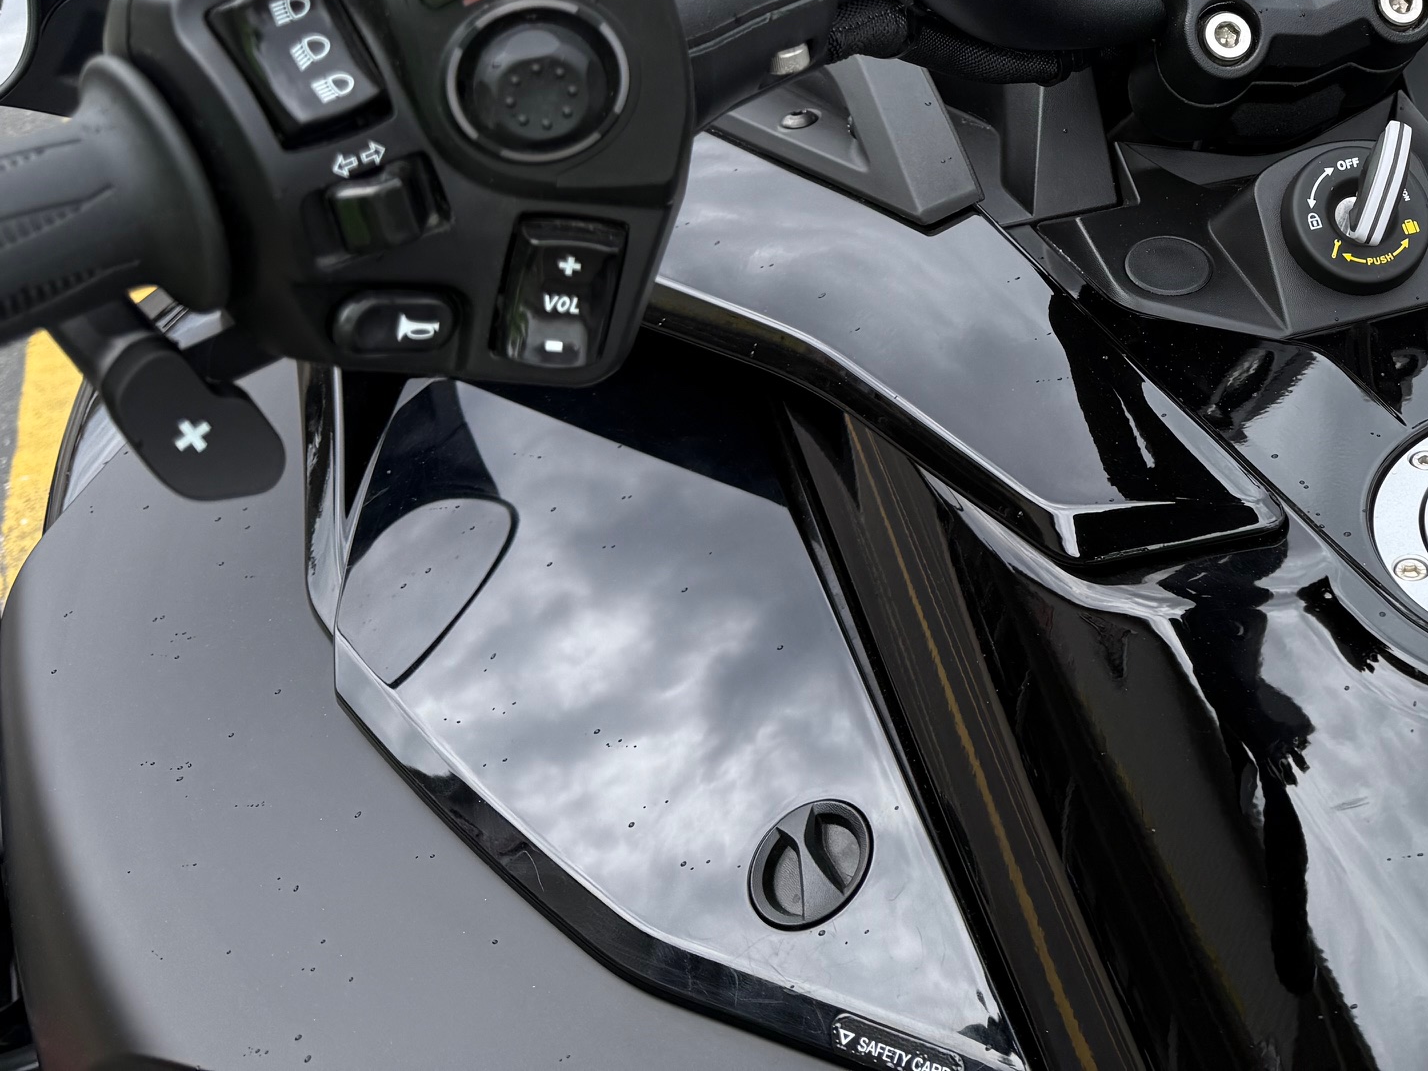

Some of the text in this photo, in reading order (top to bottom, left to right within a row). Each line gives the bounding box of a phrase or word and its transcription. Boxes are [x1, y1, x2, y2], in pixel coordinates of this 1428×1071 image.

[1336, 157, 1360, 171] OFF
[1367, 252, 1394, 266] PUSH
[543, 293, 579, 315] VOL
[857, 1037, 911, 1067] SAFETY
